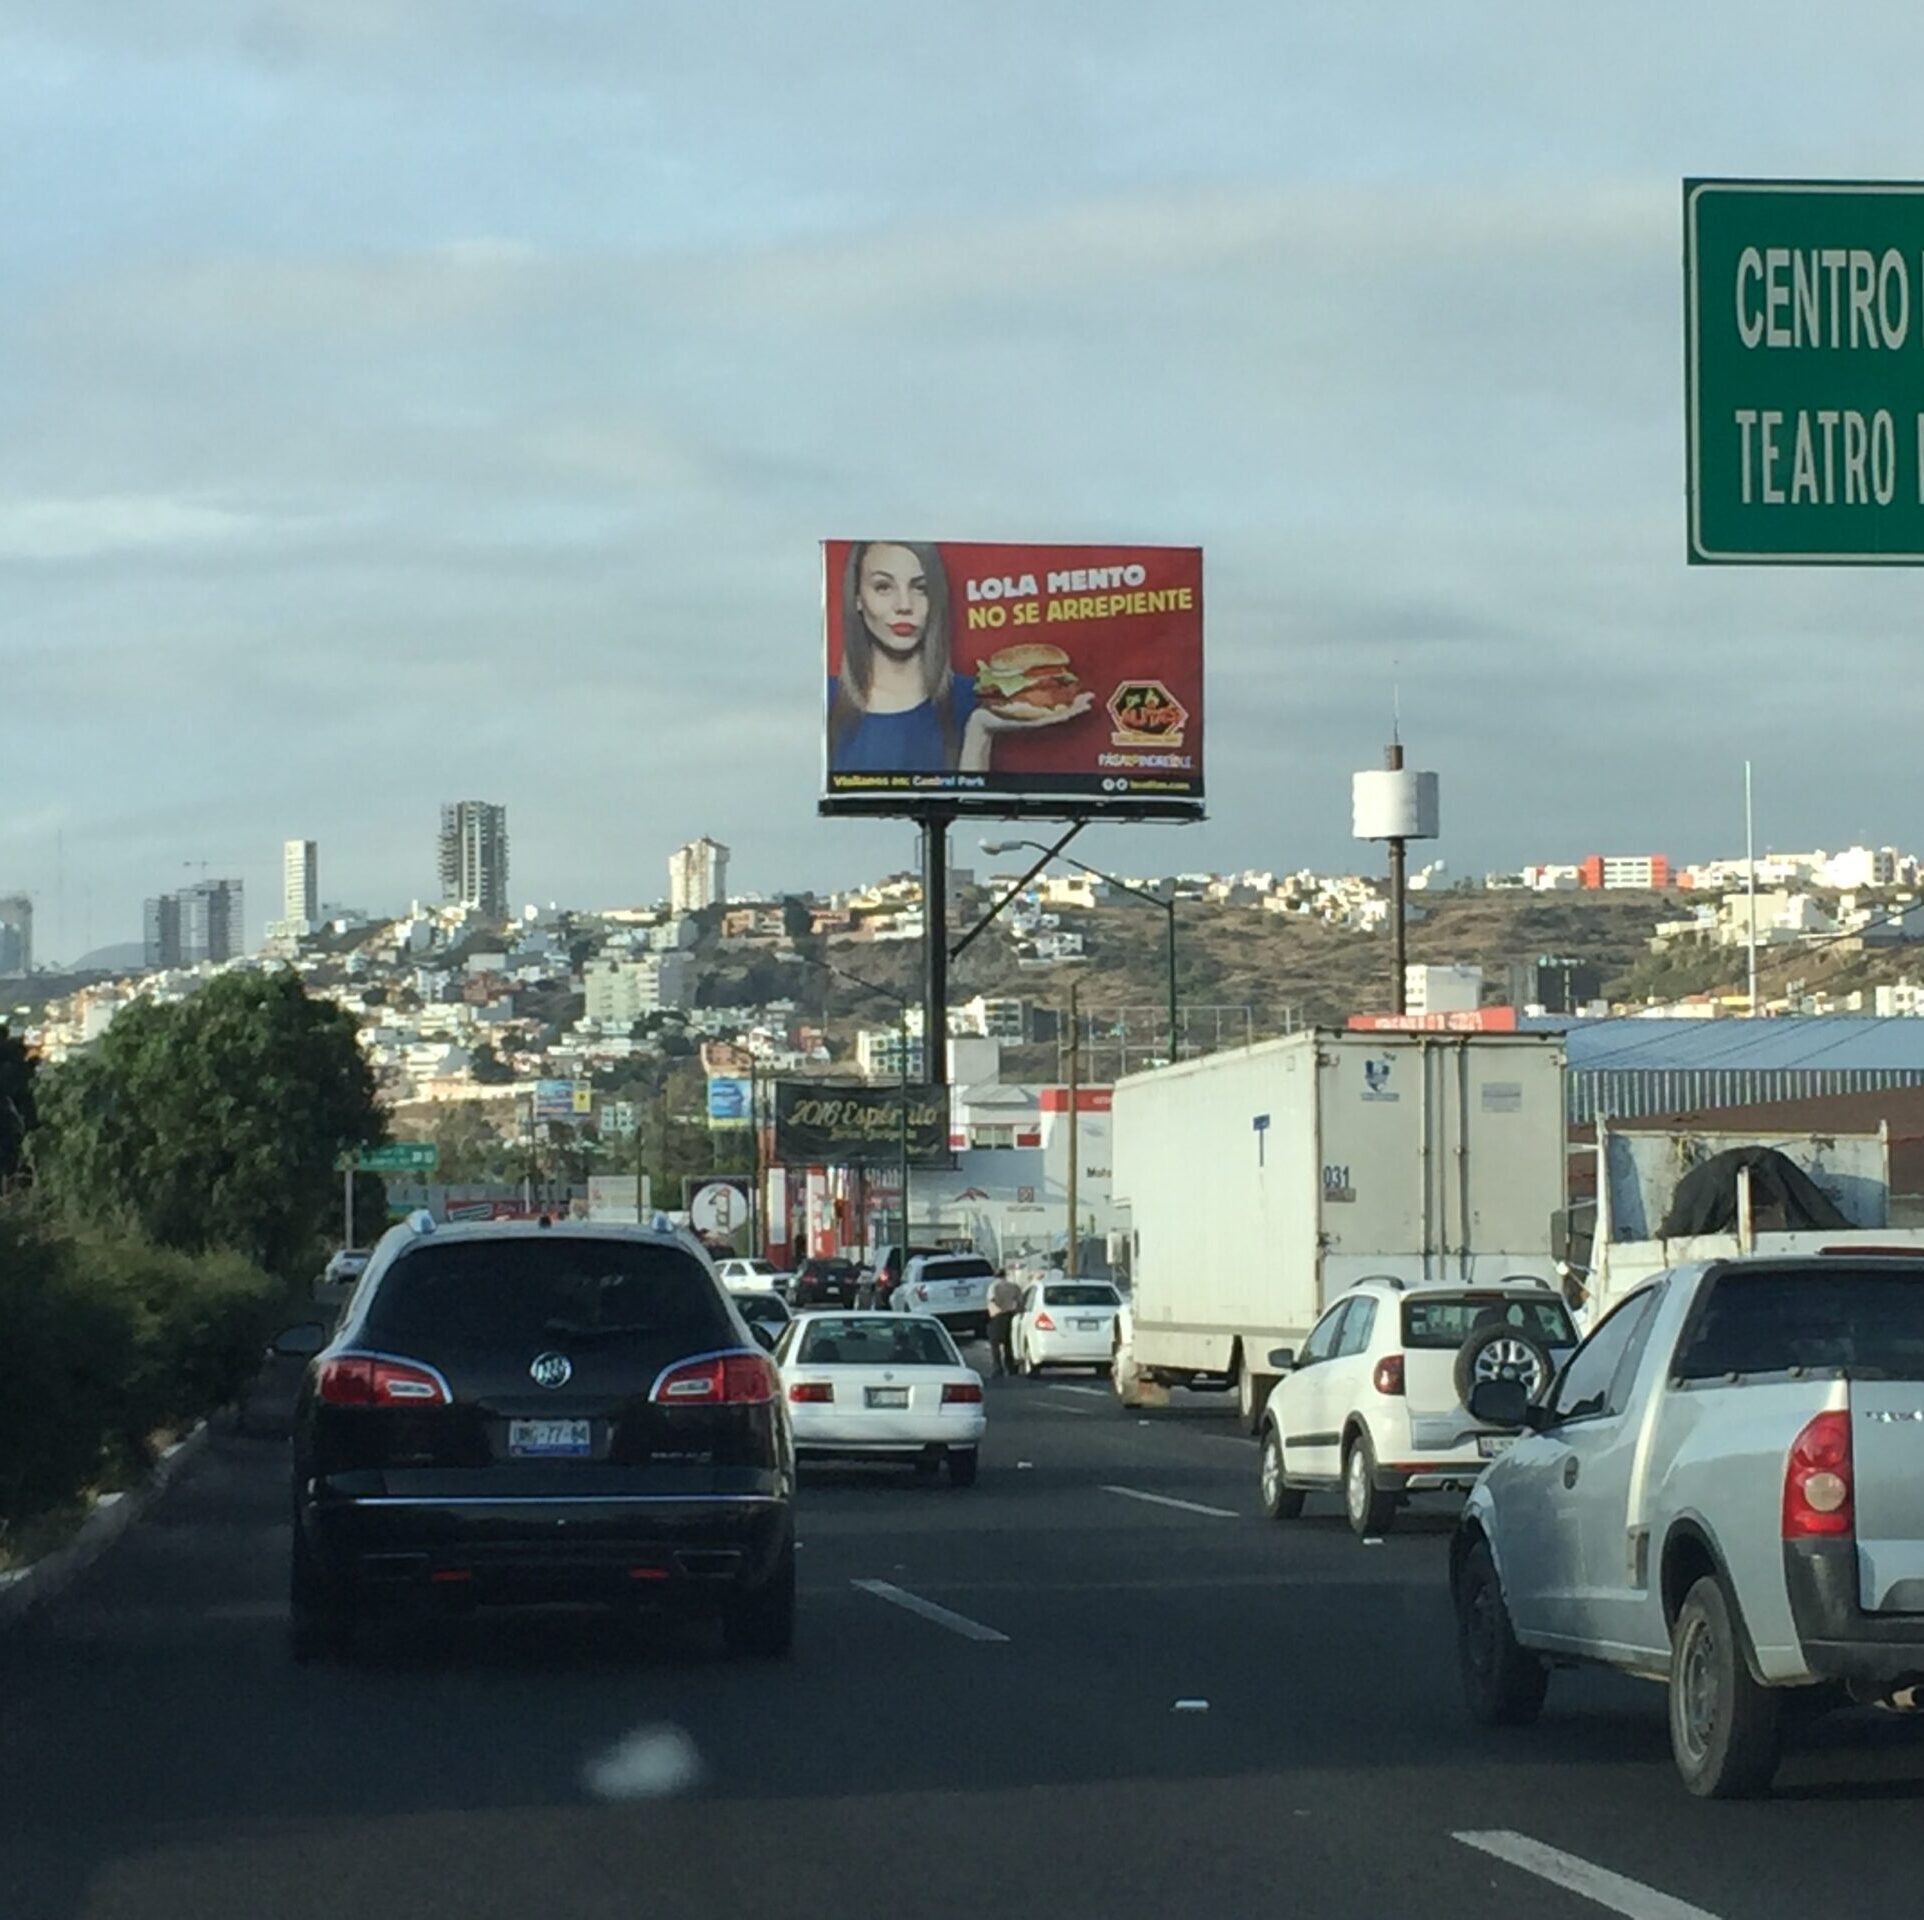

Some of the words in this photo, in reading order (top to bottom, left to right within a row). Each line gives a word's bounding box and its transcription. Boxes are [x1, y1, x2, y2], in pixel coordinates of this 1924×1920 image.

[1735, 246, 1910, 351] CENTRO
[1734, 408, 1896, 506] TEATRO
[966, 573, 1039, 602] LOLA
[1047, 564, 1147, 594] MENTO
[967, 605, 1006, 629] NO
[1013, 602, 1040, 626] SE
[1046, 587, 1193, 622] ARREPIENTE
[957, 775, 986, 787] Park
[786, 1100, 842, 1127] 2016
[1323, 1165, 1350, 1189] 031
